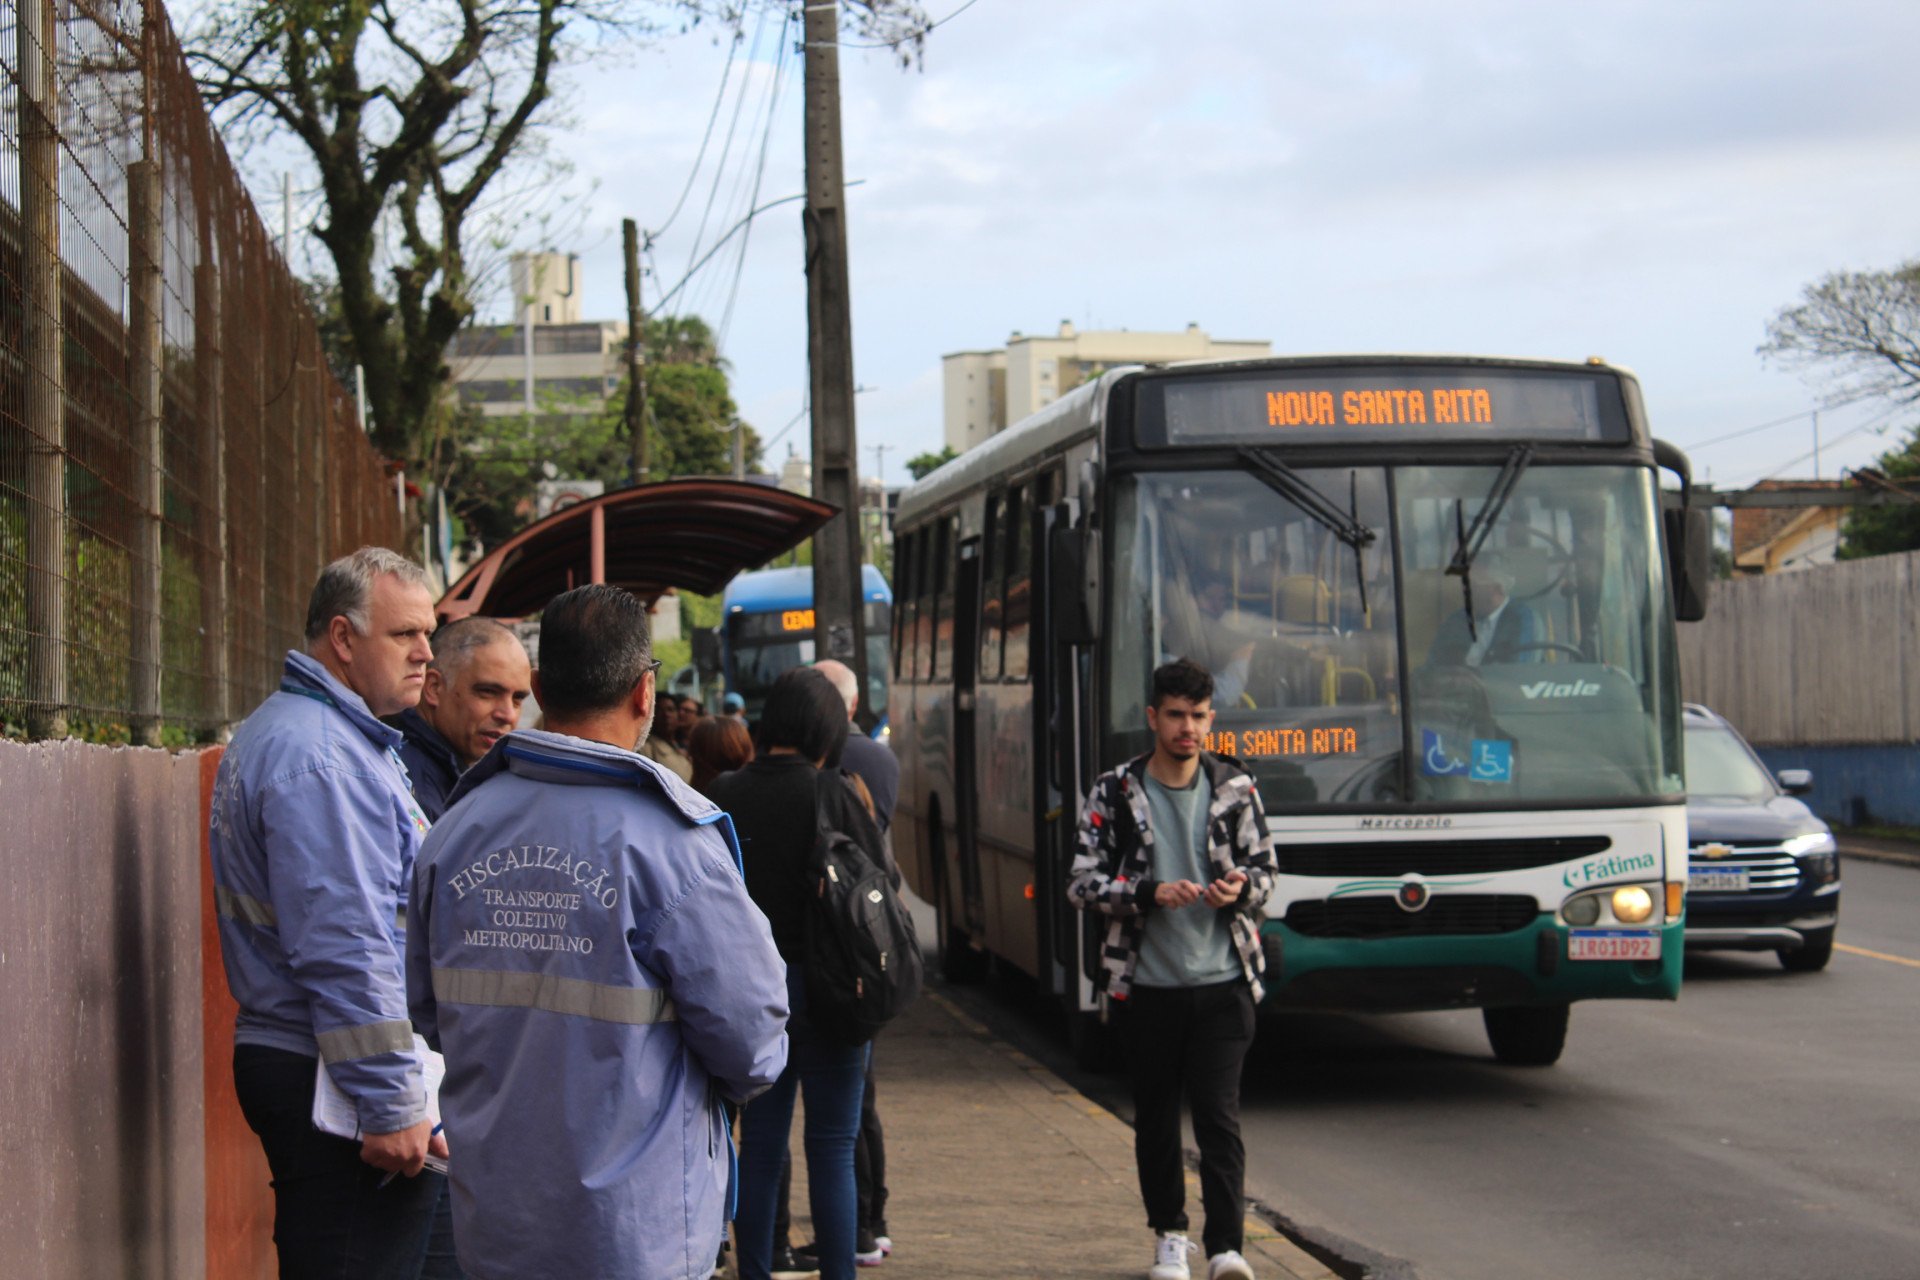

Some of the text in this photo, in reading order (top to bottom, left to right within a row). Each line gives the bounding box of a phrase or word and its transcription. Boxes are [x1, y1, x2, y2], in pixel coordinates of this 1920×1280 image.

[1267, 389, 1492, 425] NOVA SANTA RITA
[1520, 680, 1600, 699] Viale
[1243, 729, 1306, 756] SANTA
[1312, 727, 1356, 754] RITA
[1361, 817, 1452, 829] Marcopolo
[448, 845, 618, 909] FISCALIZAÇÃO
[1583, 853, 1655, 881] Fátima
[483, 889, 581, 910] TRANSPORTE
[493, 910, 567, 930] COLETIVO
[463, 929, 594, 955] METROPOLITANO
